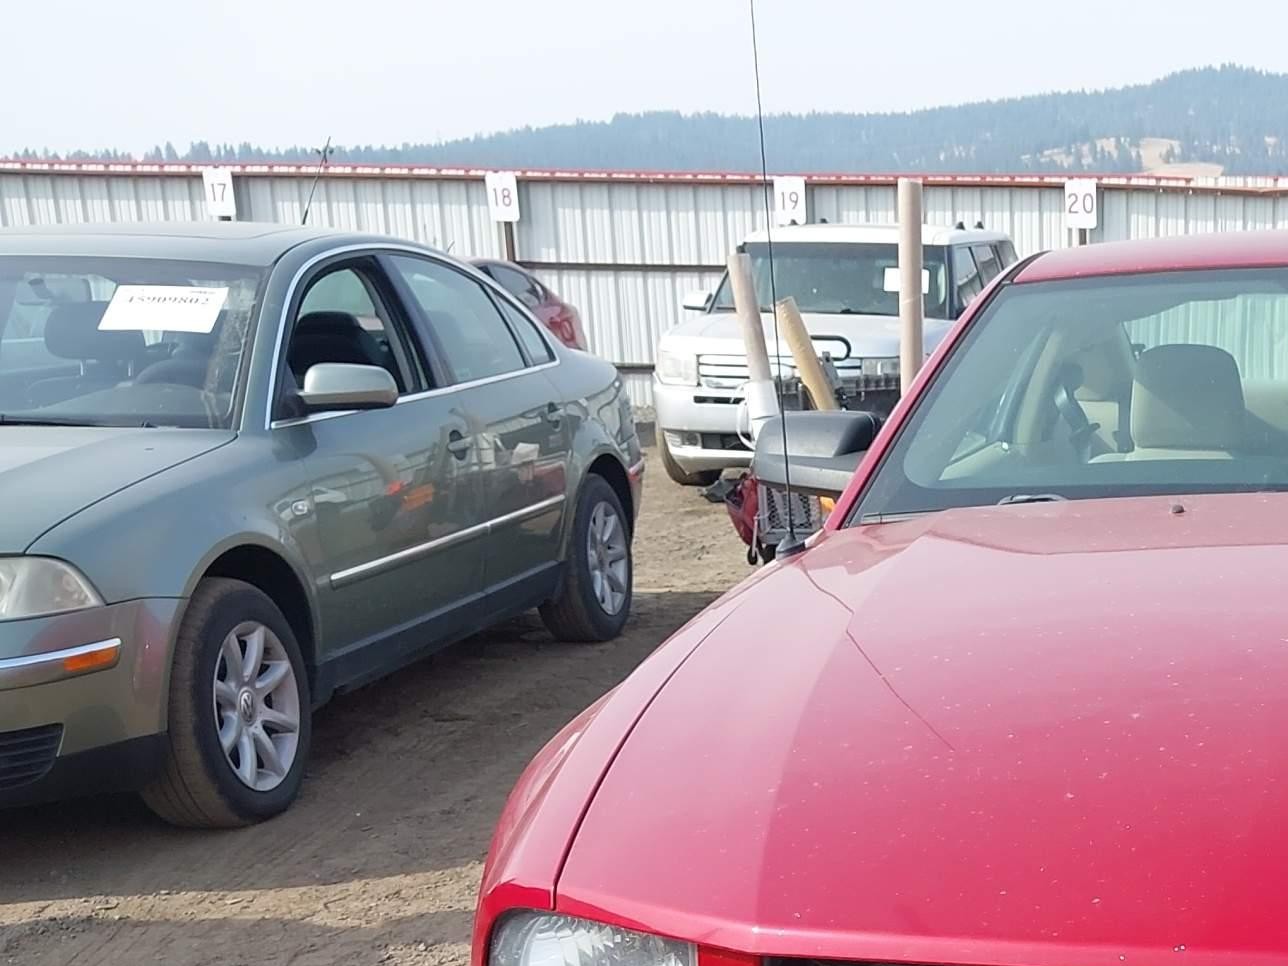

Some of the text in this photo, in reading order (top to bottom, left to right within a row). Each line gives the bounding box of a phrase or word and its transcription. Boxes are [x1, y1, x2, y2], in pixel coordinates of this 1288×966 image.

[210, 182, 227, 202] 17
[492, 187, 512, 207] 18
[780, 191, 799, 210] 19
[1067, 192, 1094, 214] 20
